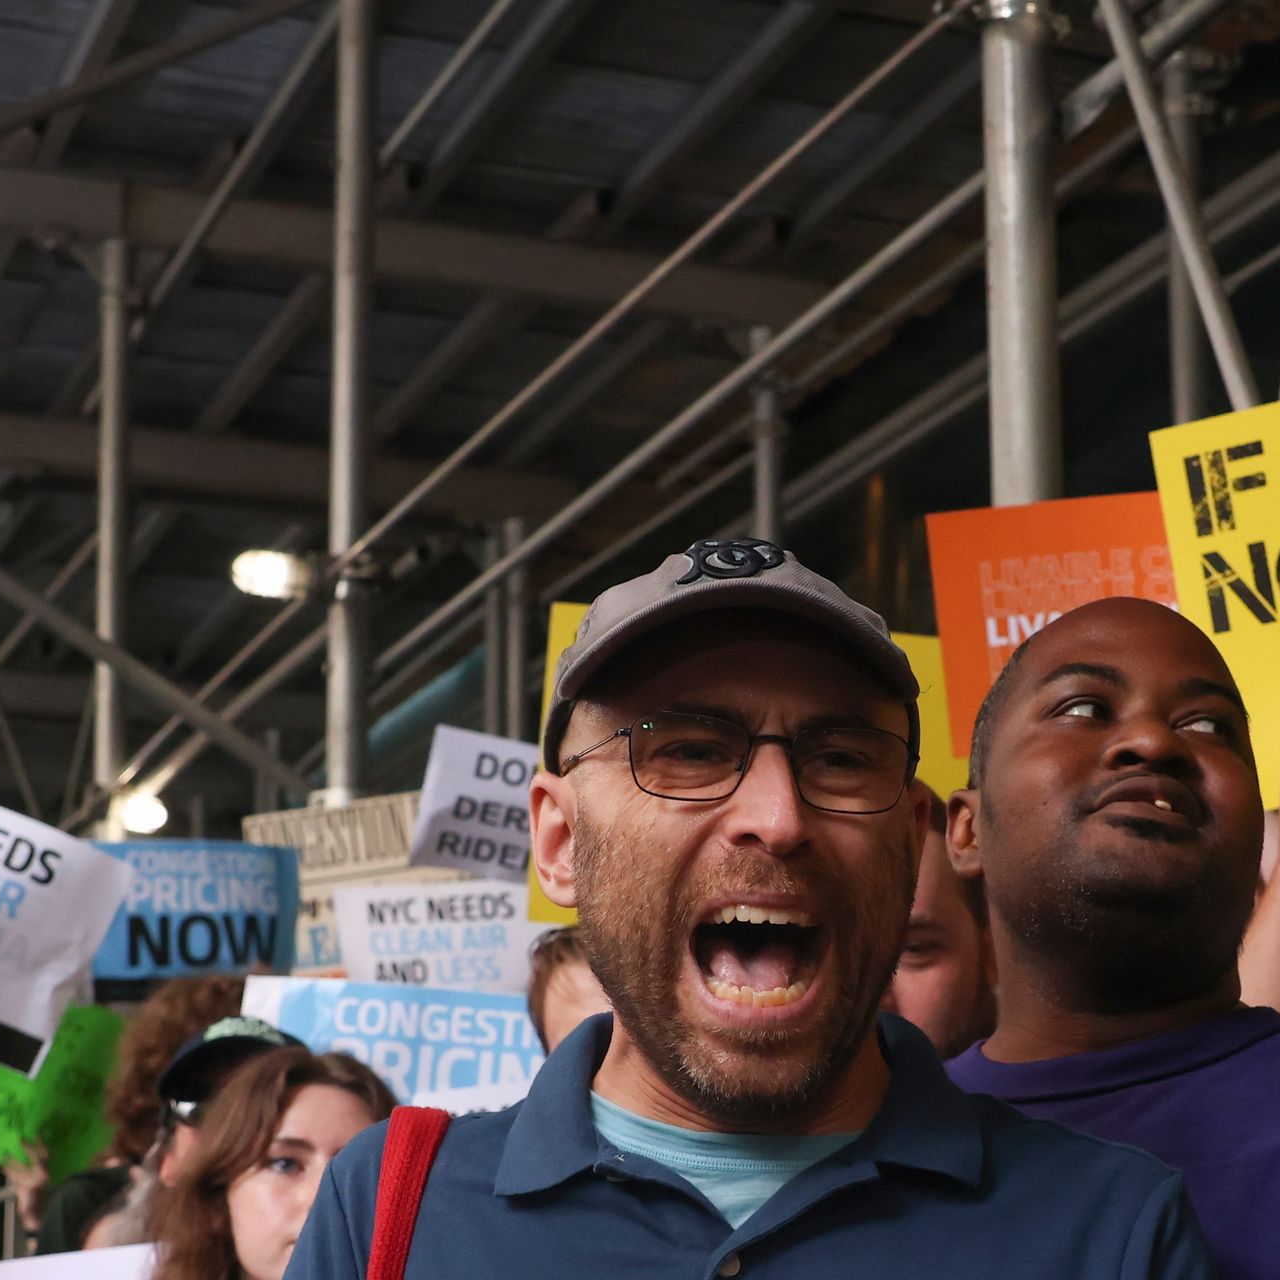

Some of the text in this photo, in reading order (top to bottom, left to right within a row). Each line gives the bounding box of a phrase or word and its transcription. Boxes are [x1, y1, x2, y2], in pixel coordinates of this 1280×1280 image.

[1183, 439, 1268, 538] IF
[474, 751, 538, 787] DO
[452, 795, 530, 834] DER
[124, 874, 280, 912] PRICING
[367, 898, 418, 926] NYC
[425, 891, 517, 924] NEEDS
[128, 912, 279, 968] NOW
[370, 927, 455, 956] CLEAN
[462, 923, 510, 951] AIR
[375, 954, 503, 985] AND LESS
